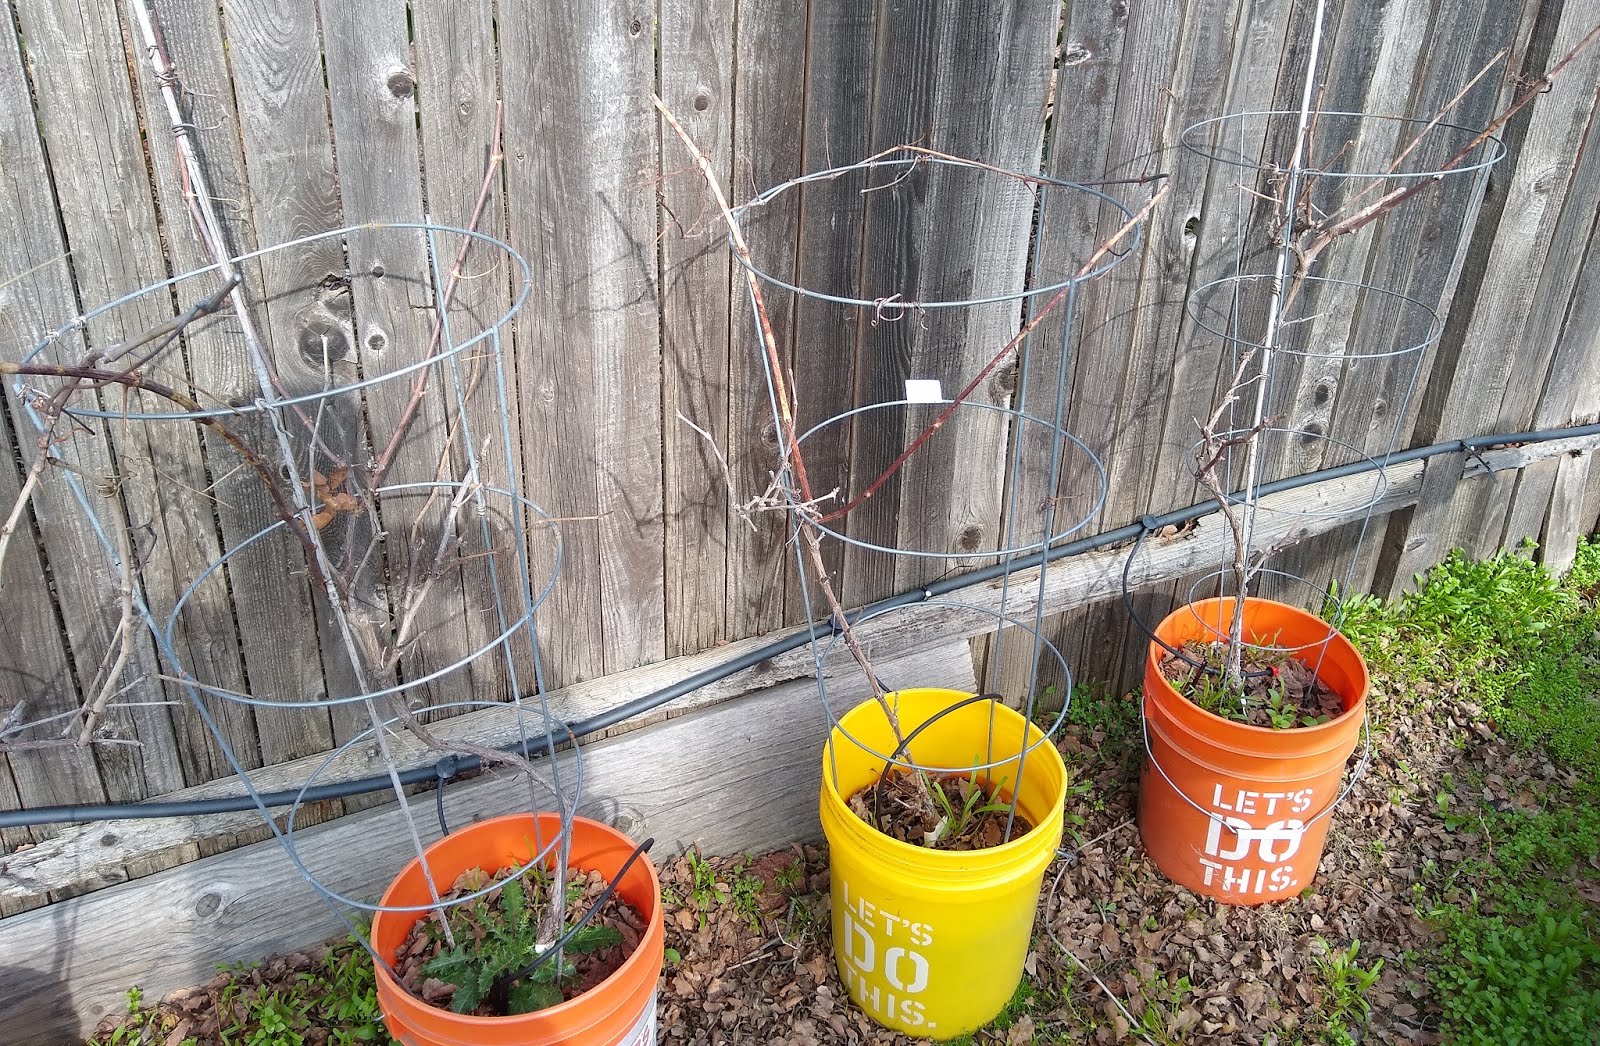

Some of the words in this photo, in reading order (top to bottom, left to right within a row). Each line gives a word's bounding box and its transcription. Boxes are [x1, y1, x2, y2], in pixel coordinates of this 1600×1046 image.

[1212, 783, 1313, 816] LET'S
[1204, 811, 1304, 863] DO
[1199, 857, 1298, 894] THIS.
[843, 880, 934, 946] LET'S
[843, 910, 930, 993] DO
[842, 955, 937, 1029] THIS.
